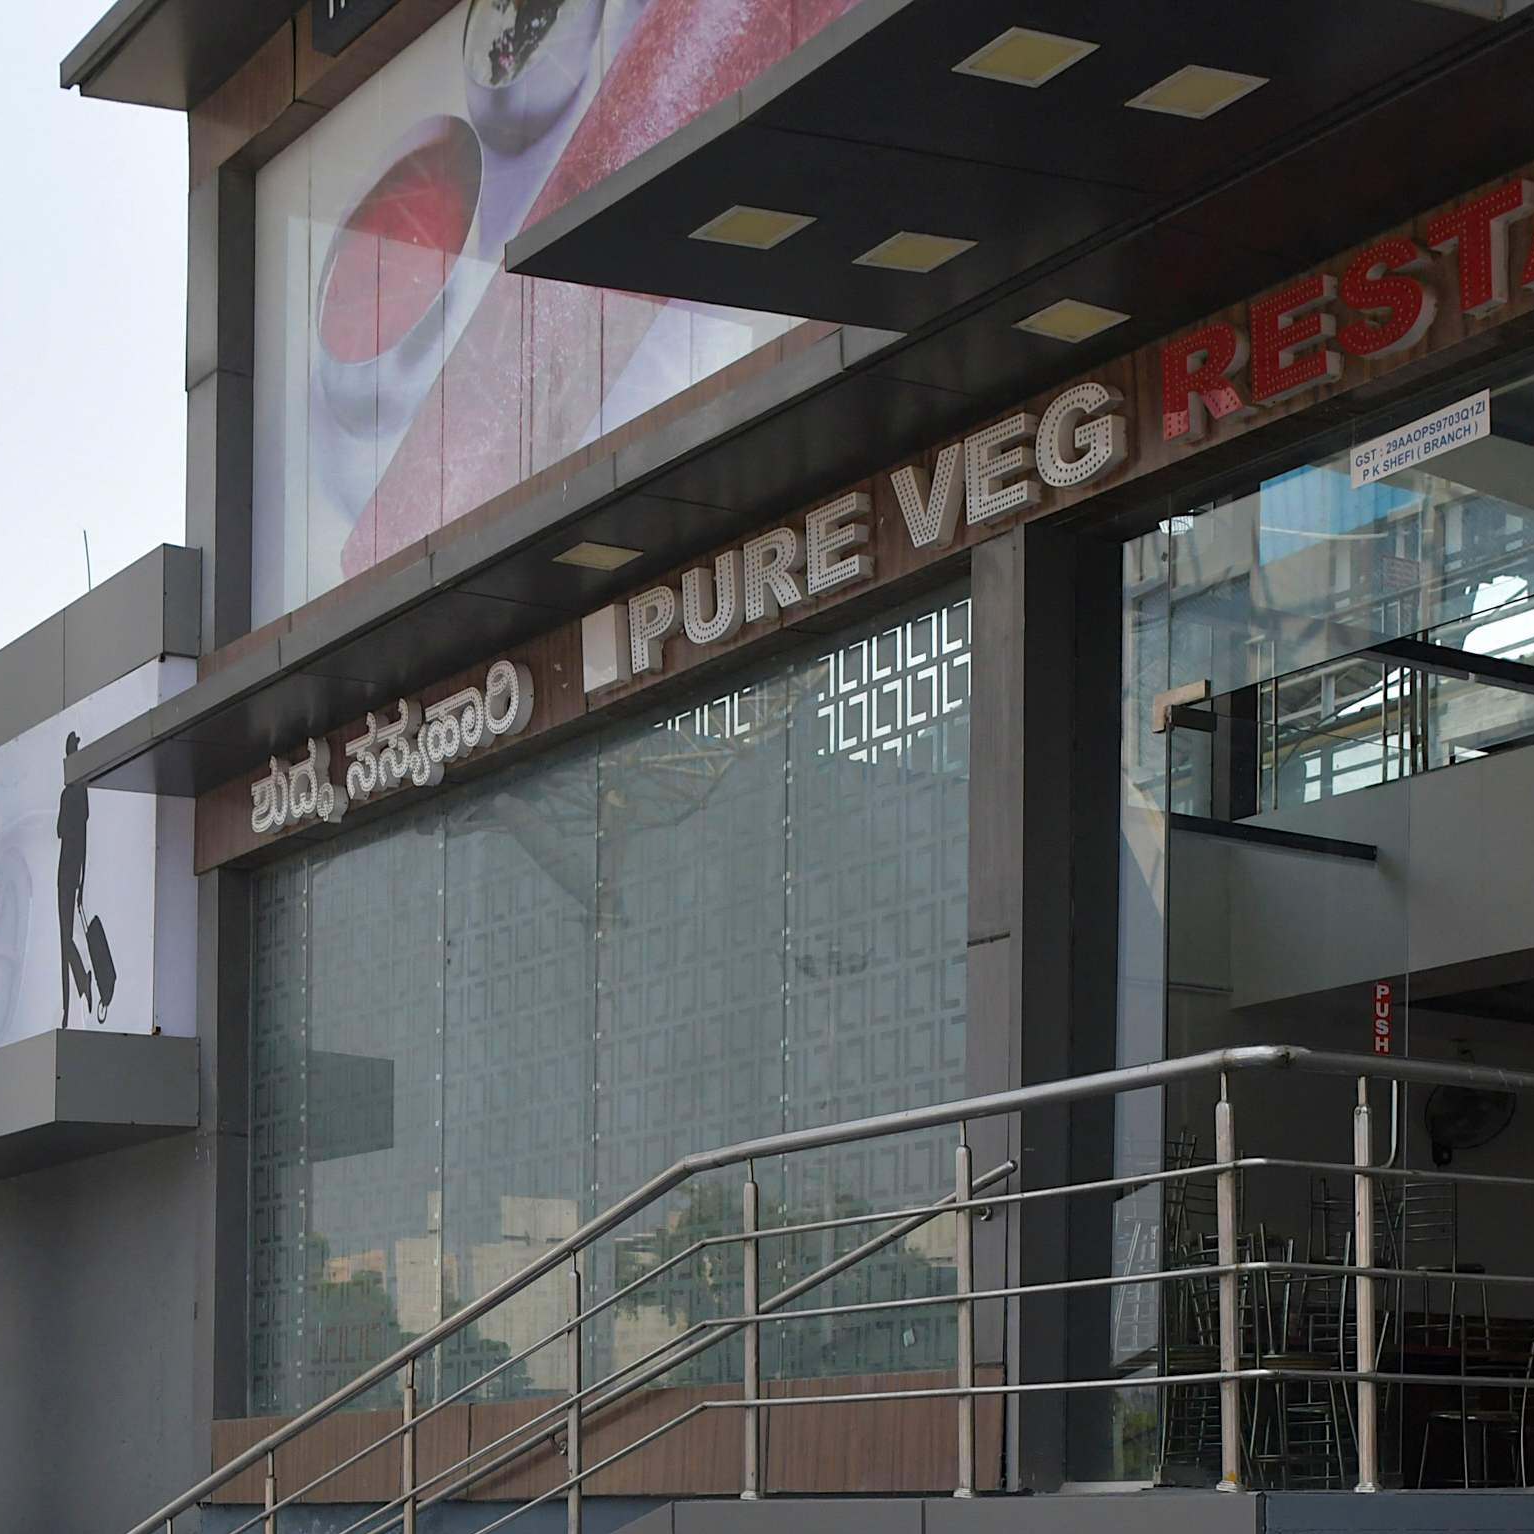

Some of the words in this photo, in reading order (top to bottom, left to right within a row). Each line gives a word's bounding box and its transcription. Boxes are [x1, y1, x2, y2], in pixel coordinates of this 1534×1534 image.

[1355, 449, 1378, 467] GST
[1362, 469, 1370, 481] P
[1372, 465, 1380, 476] K
[1383, 452, 1415, 473] SHEFI
[1424, 425, 1472, 455] BRANCH
[628, 492, 869, 674] PURE
[890, 381, 1124, 549] VEG
[251, 737, 339, 833] ಶುದ್ಧ
[1375, 984, 1390, 1053] PUSH
